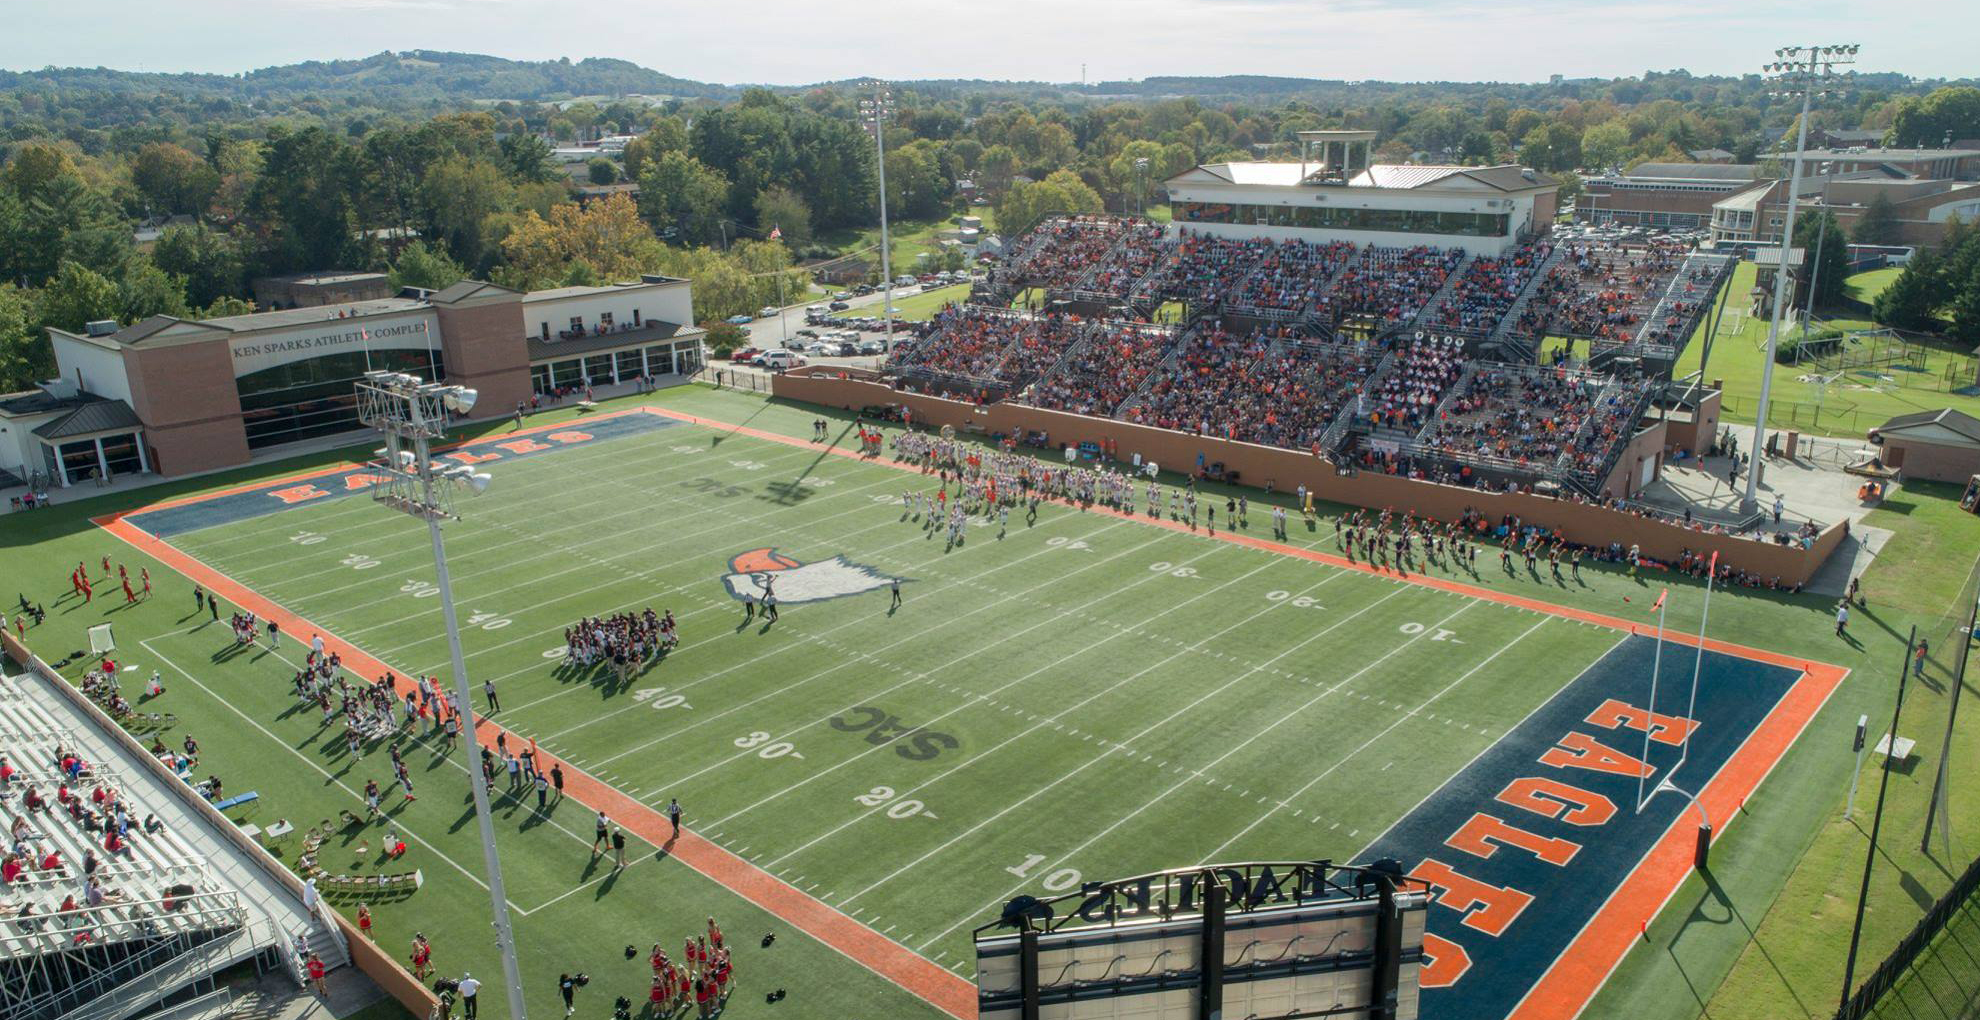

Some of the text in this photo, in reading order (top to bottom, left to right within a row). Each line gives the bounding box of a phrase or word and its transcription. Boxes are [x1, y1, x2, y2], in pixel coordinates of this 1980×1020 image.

[233, 345, 261, 358] KEN
[264, 339, 311, 354] SPARKS
[268, 431, 594, 504] EALES
[290, 531, 327, 545] 10
[1046, 536, 1089, 552] 40
[340, 554, 381, 569] 20
[1149, 561, 1196, 580] 30
[400, 581, 440, 598] 30
[1265, 590, 1319, 608] 20
[467, 612, 512, 630] 40
[1399, 622, 1457, 642] 10
[632, 687, 685, 709] 40
[829, 706, 959, 761] SAC
[734, 731, 794, 759] 30
[853, 786, 924, 819] 20
[1006, 853, 1082, 891] 10
